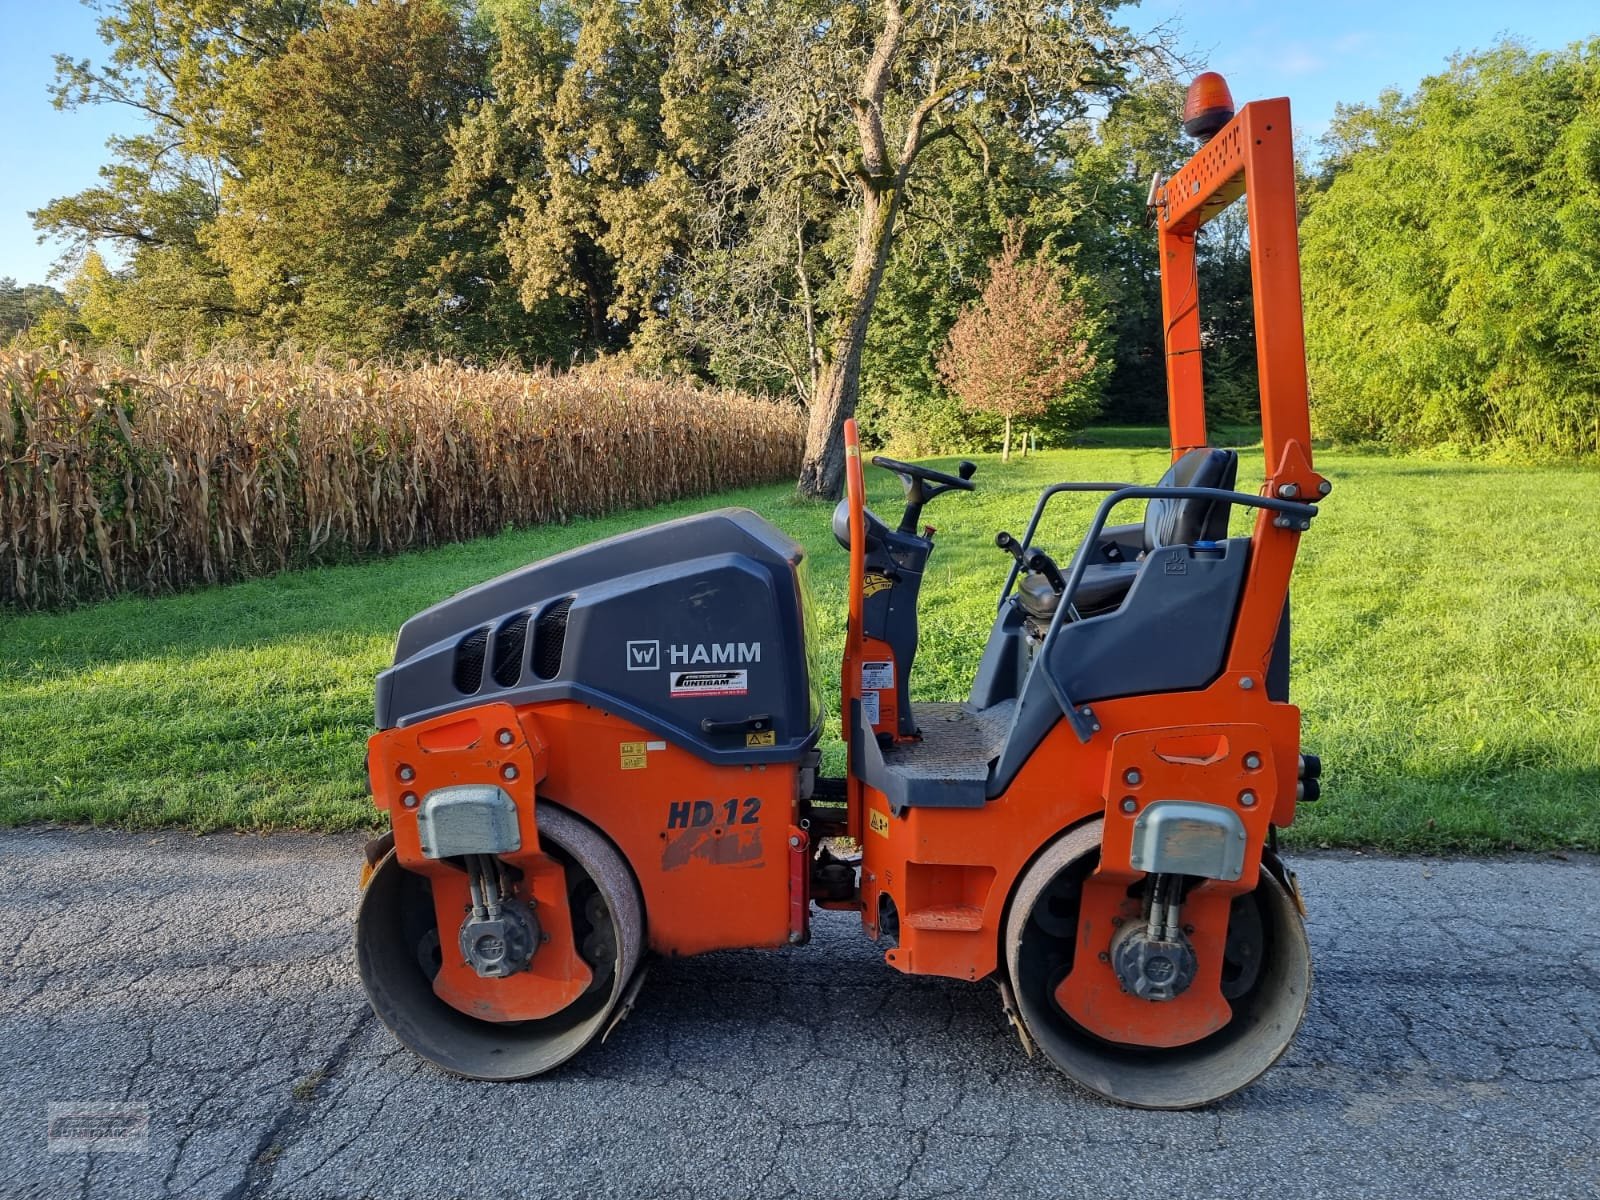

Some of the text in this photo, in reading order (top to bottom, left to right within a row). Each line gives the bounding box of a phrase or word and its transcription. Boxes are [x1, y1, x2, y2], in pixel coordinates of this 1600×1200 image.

[670, 642, 761, 665] HAMM
[667, 797, 761, 830] HD 12
